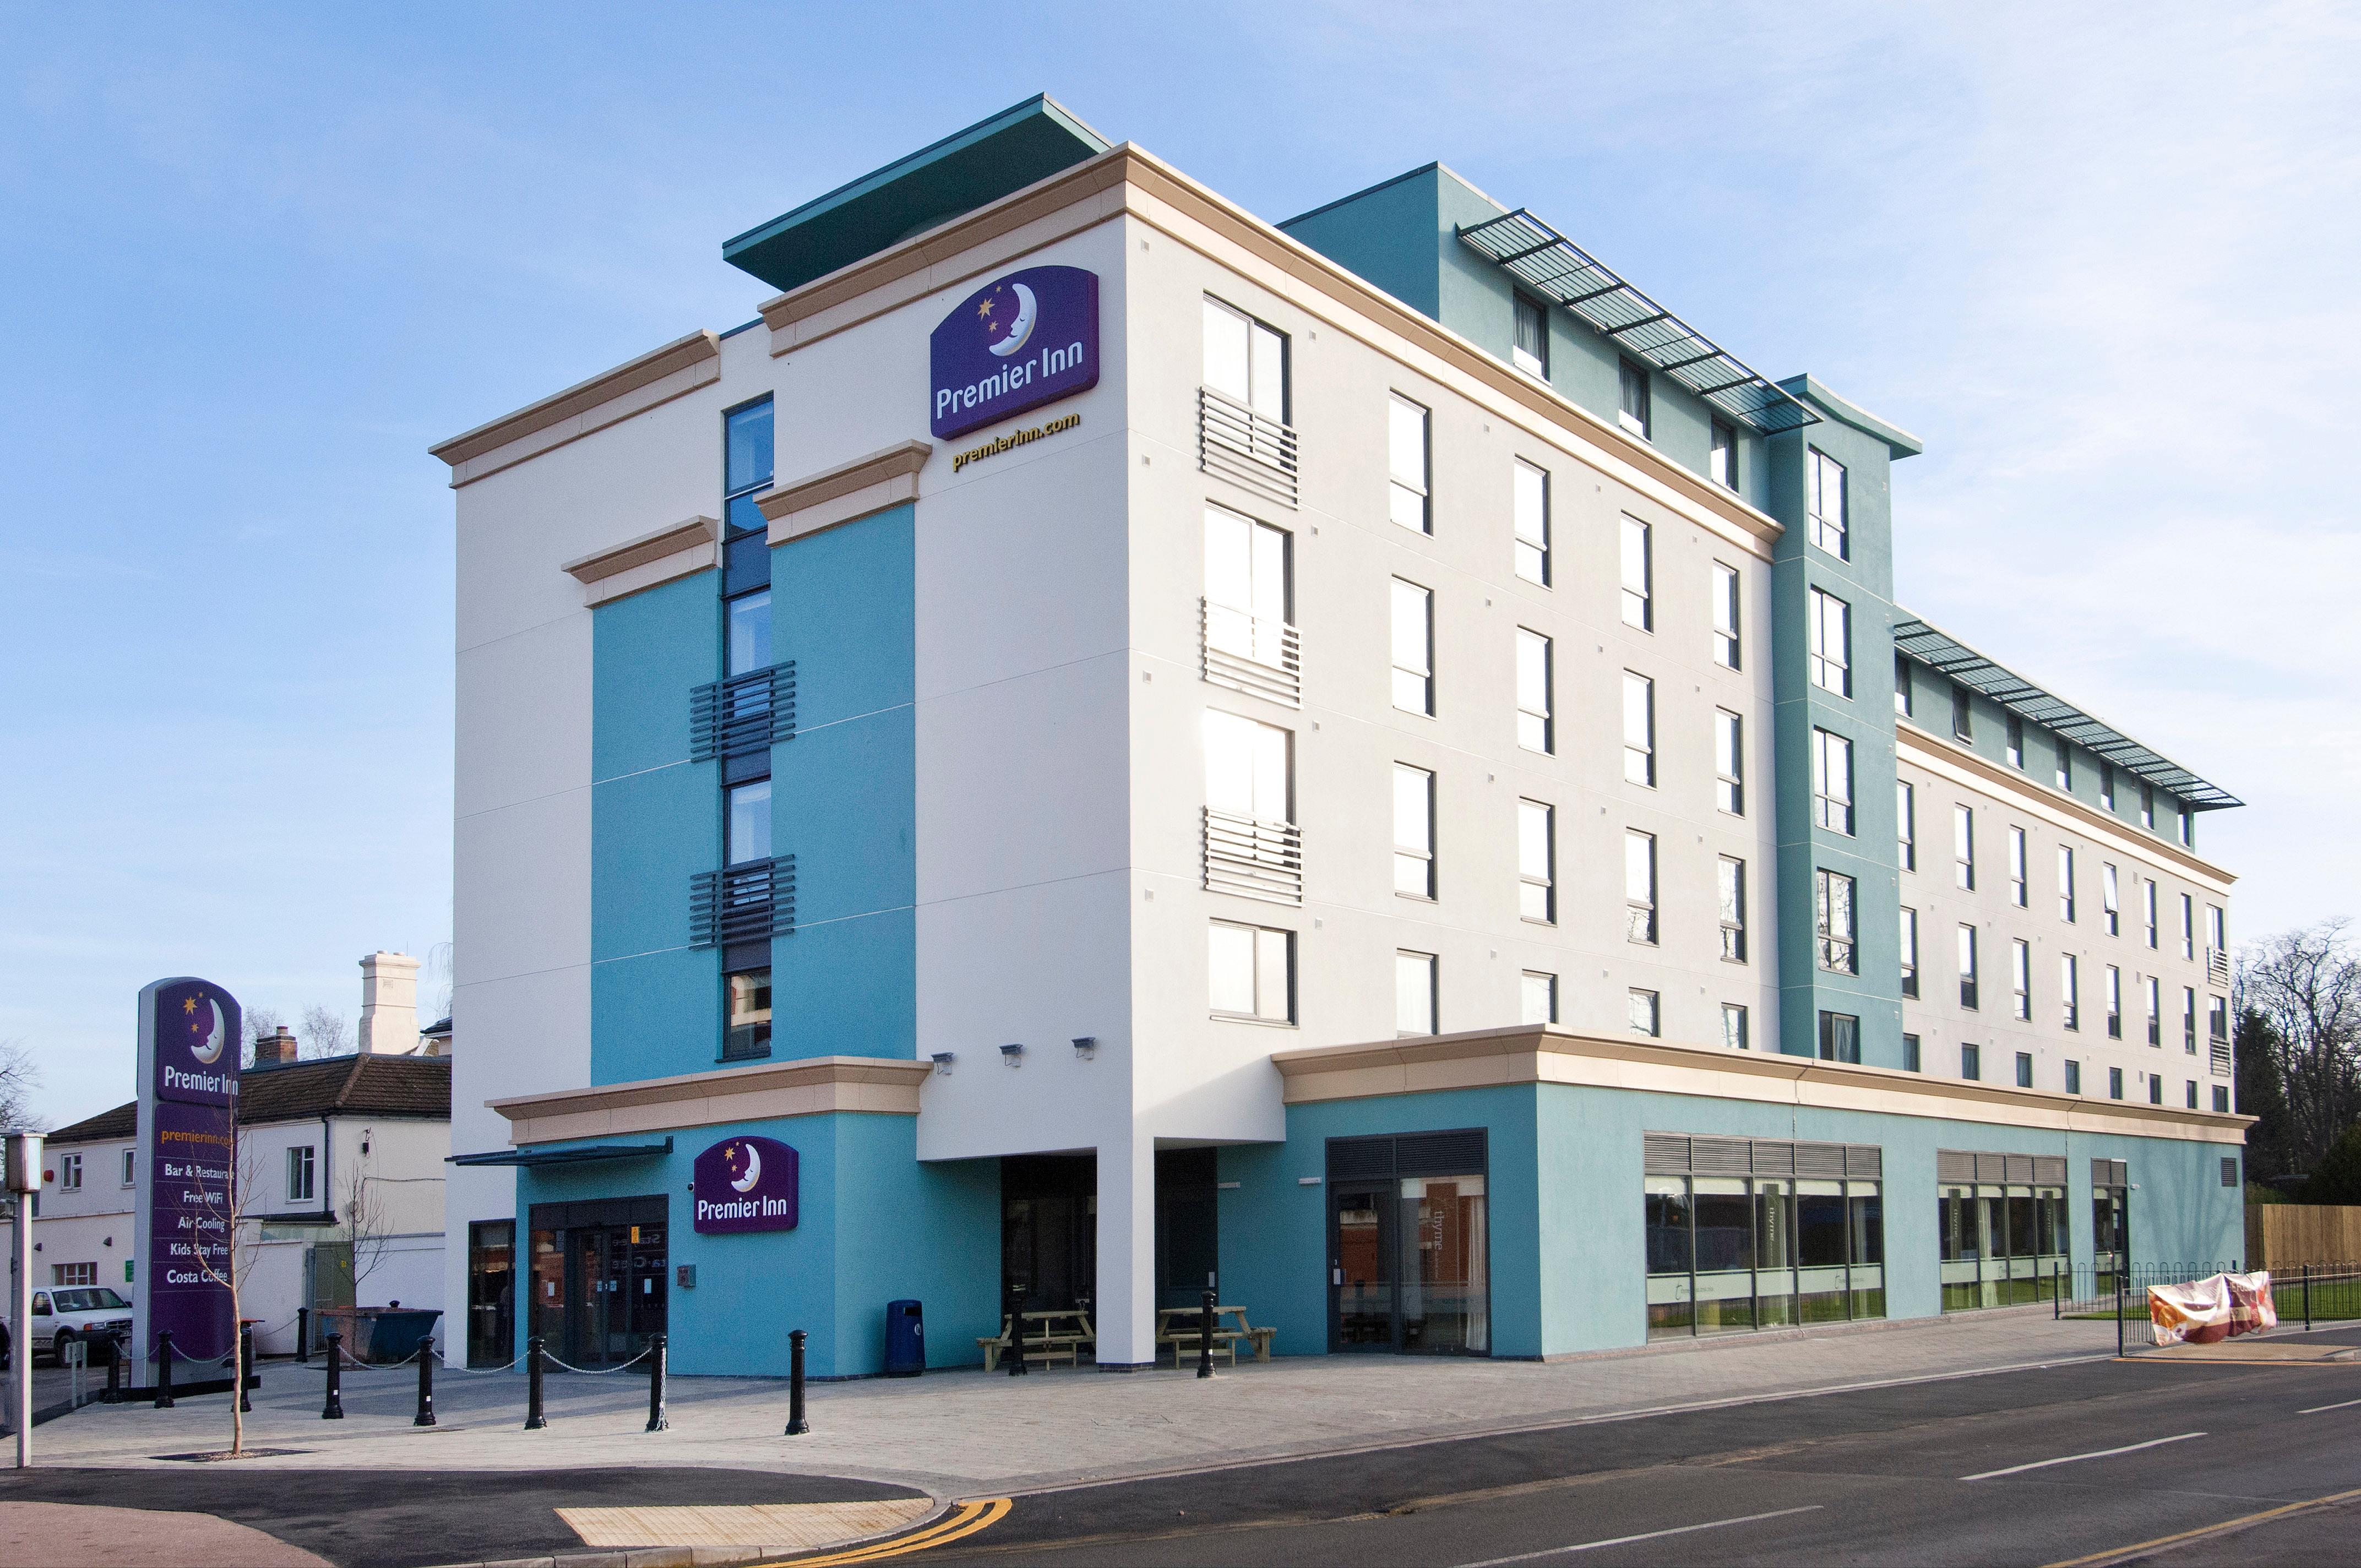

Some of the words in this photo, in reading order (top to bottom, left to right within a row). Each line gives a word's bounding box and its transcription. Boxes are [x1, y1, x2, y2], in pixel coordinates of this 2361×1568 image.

[937, 359, 1037, 419] Premier
[1042, 341, 1083, 378] Inn
[953, 412, 1080, 472] premierinn.com
[165, 1065, 220, 1092] Premier
[222, 1074, 238, 1096] Inn
[165, 1163, 183, 1177] Bar
[186, 1164, 193, 1177] &
[195, 1166, 235, 1180] Restaurat
[184, 1190, 203, 1203] Free
[205, 1191, 223, 1204] WiFi
[698, 1197, 760, 1221] Premier
[763, 1195, 787, 1216] Inn
[178, 1216, 194, 1229] Air
[196, 1217, 225, 1232] Cooling
[1433, 1211, 1445, 1250] thyme
[170, 1243, 191, 1255] Kids
[213, 1243, 228, 1255] Free
[167, 1269, 198, 1283] Costa
